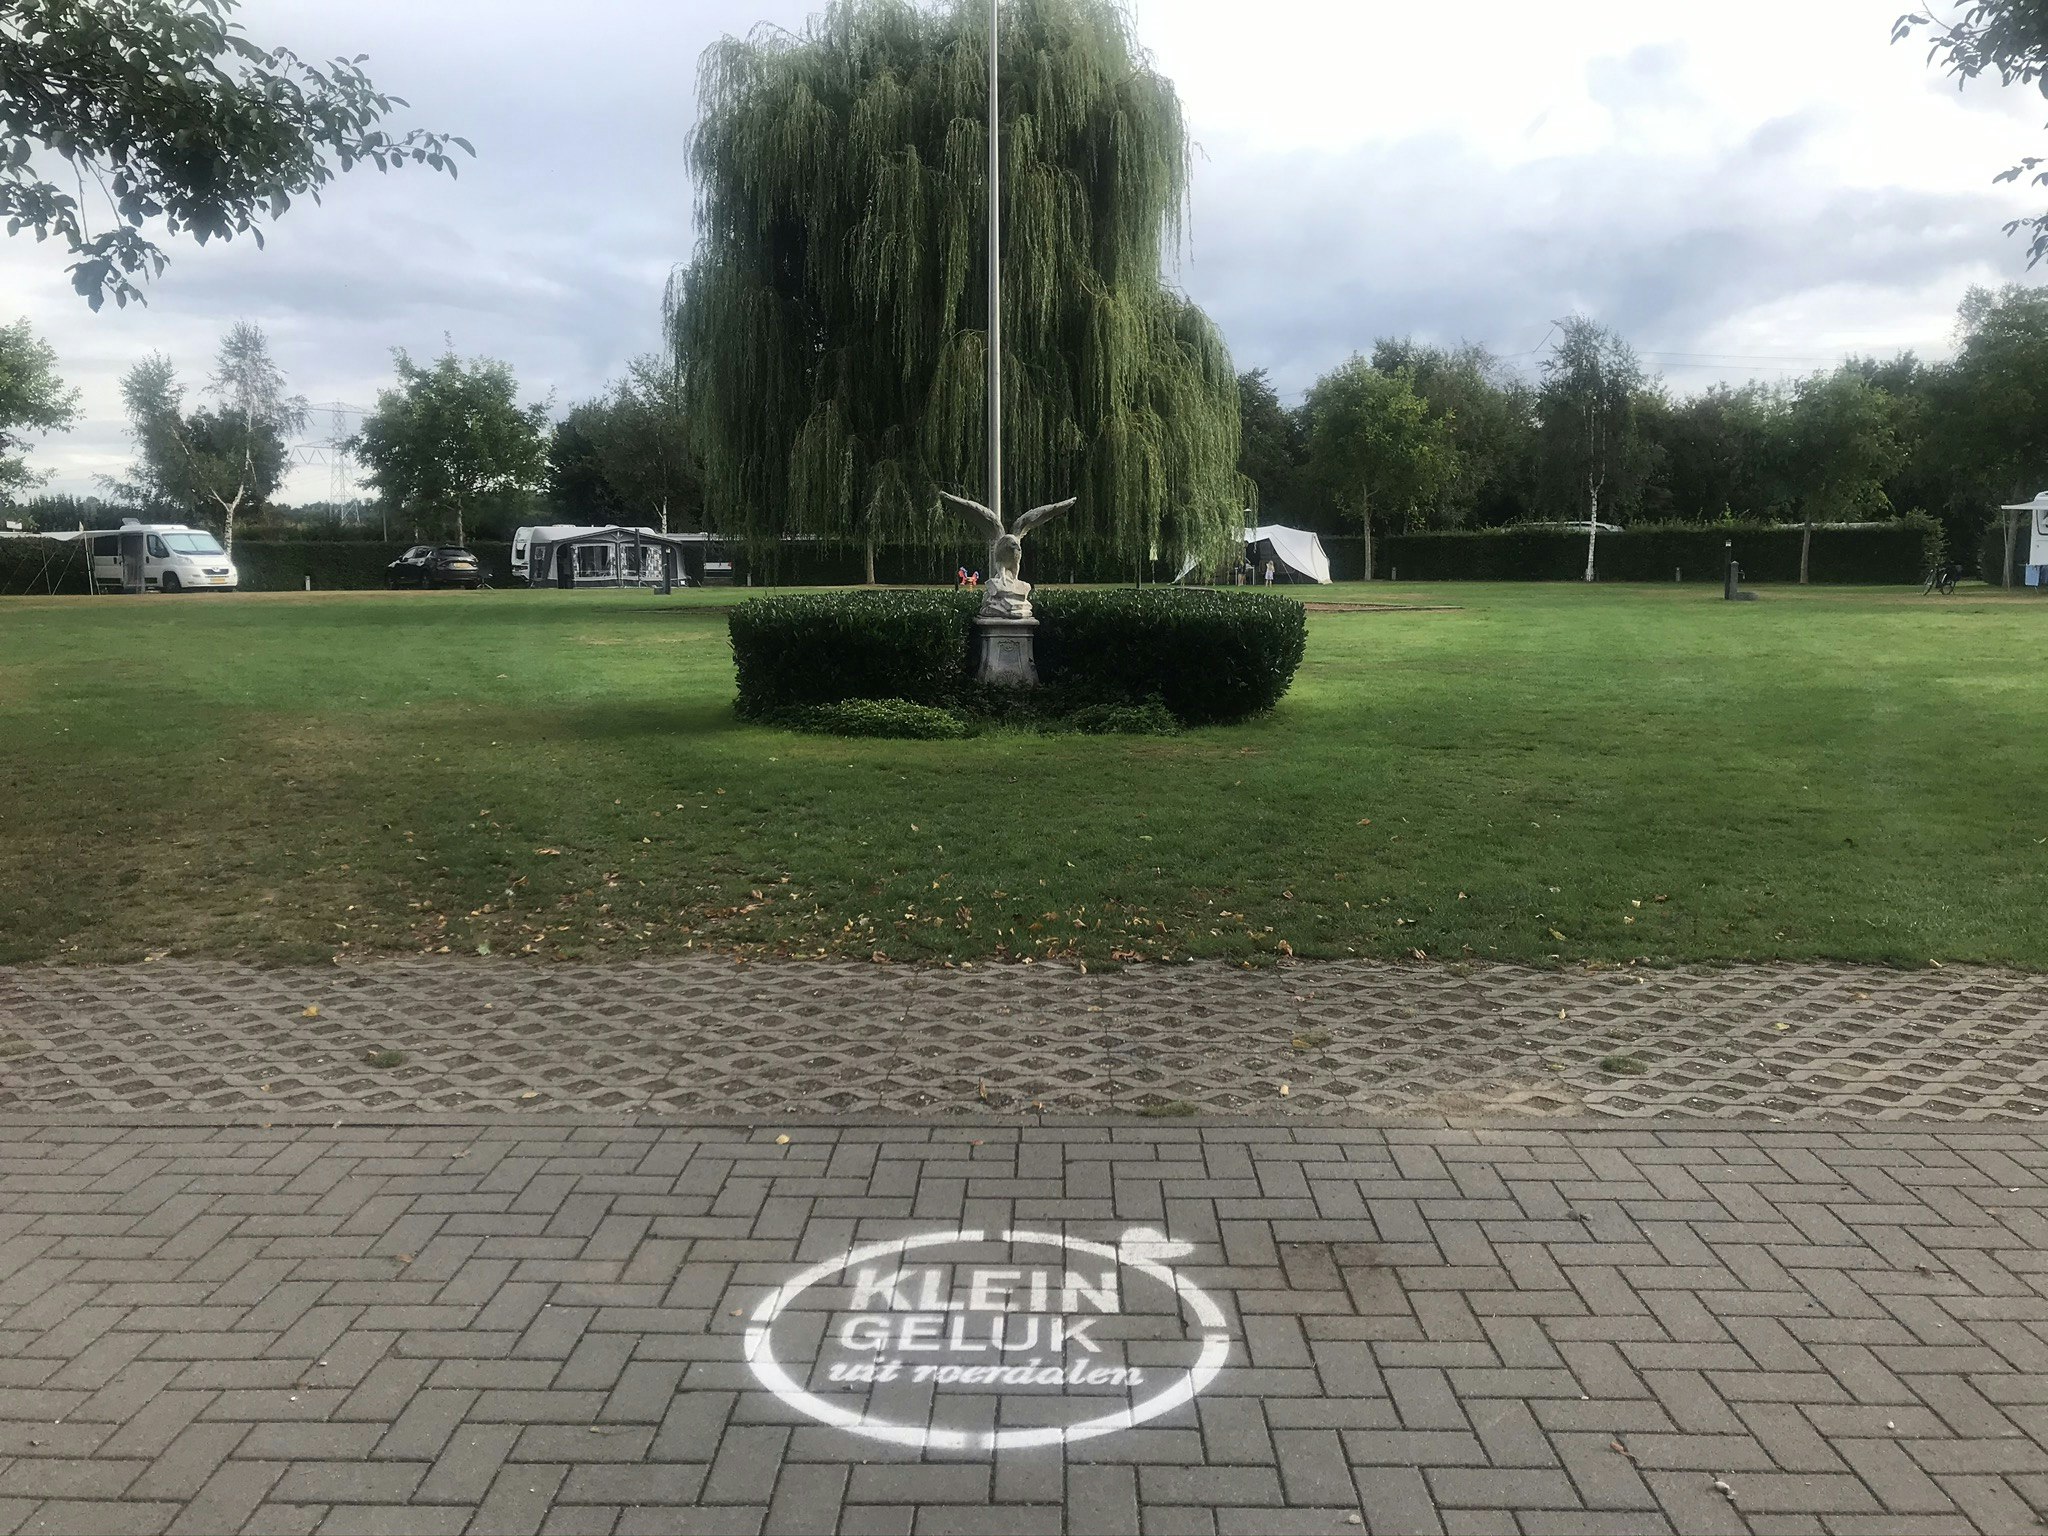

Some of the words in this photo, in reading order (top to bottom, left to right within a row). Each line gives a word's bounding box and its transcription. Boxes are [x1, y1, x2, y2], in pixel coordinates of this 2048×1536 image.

[849, 1268, 1121, 1314] KLEIN
[840, 1315, 1103, 1353] GELUK
[828, 1357, 903, 1383] uit
[912, 1358, 1145, 1386] roerdalen
